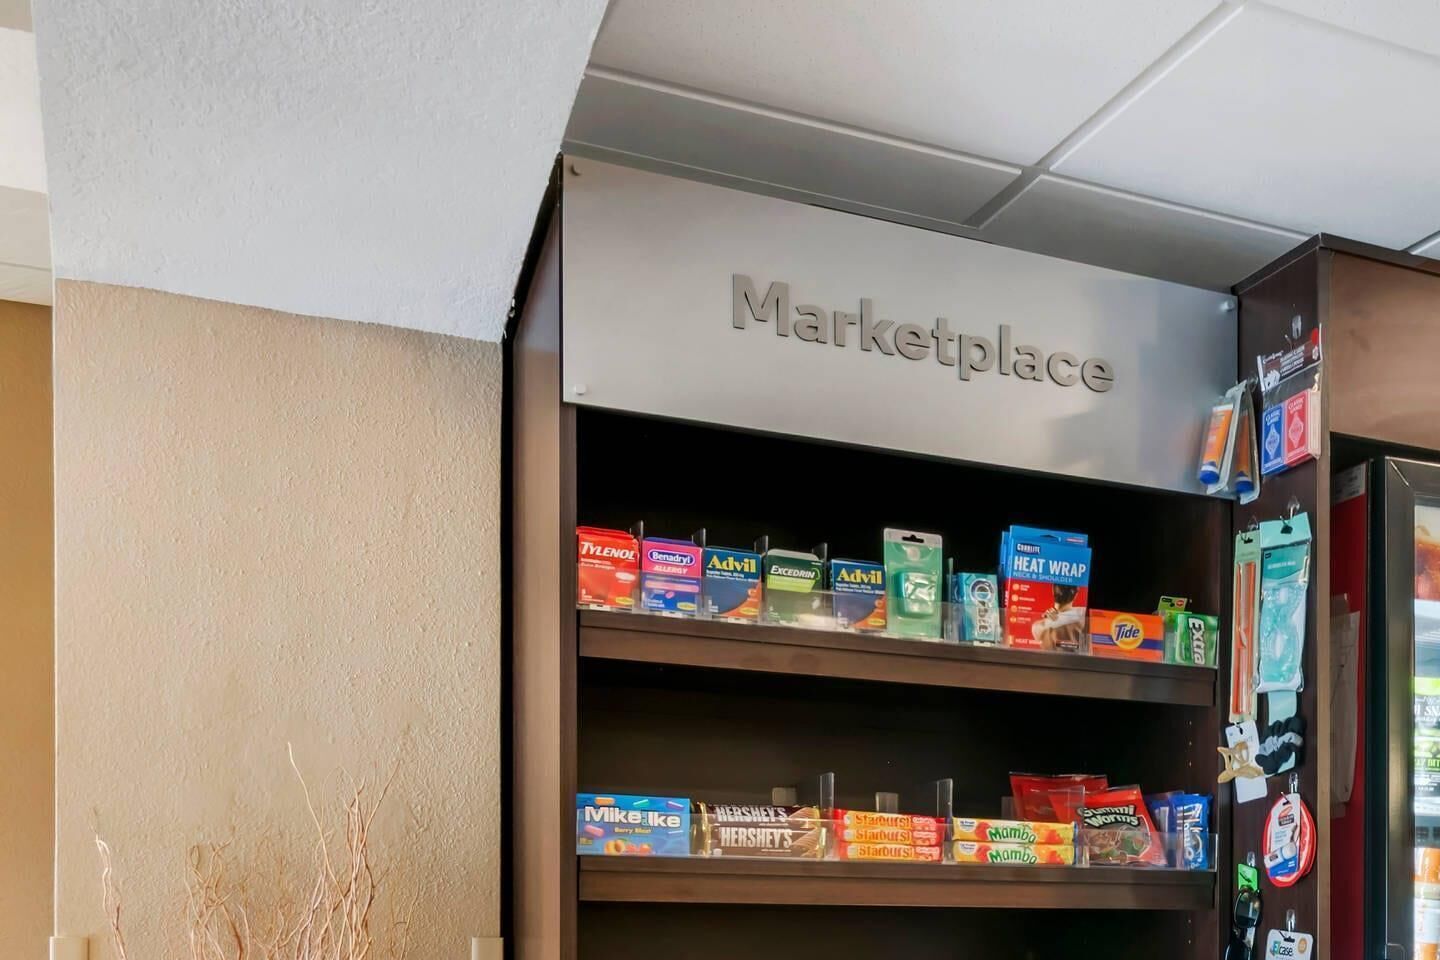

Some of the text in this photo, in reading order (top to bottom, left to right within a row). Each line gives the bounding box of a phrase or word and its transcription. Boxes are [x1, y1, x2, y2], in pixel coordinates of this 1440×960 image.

[731, 272, 1116, 393] Marketplace
[580, 541, 636, 560] TYLENOL
[651, 551, 692, 565] Benadryl
[653, 564, 689, 575] ALLERGY
[707, 554, 757, 574] Advil
[770, 565, 816, 579] EXCEDRIN
[1013, 555, 1087, 578] HEAT WRAP
[837, 567, 883, 585] Advil
[1114, 623, 1140, 642] Tide
[583, 804, 642, 824] Mike
[647, 811, 681, 828] Ike
[714, 805, 788, 823] HERSHEY'S
[1077, 804, 1136, 816] Gummi
[1084, 813, 1140, 828] Worms
[719, 826, 793, 849] HERSHEY'S
[856, 829, 912, 842] Starburst
[859, 845, 914, 858] Starburst
